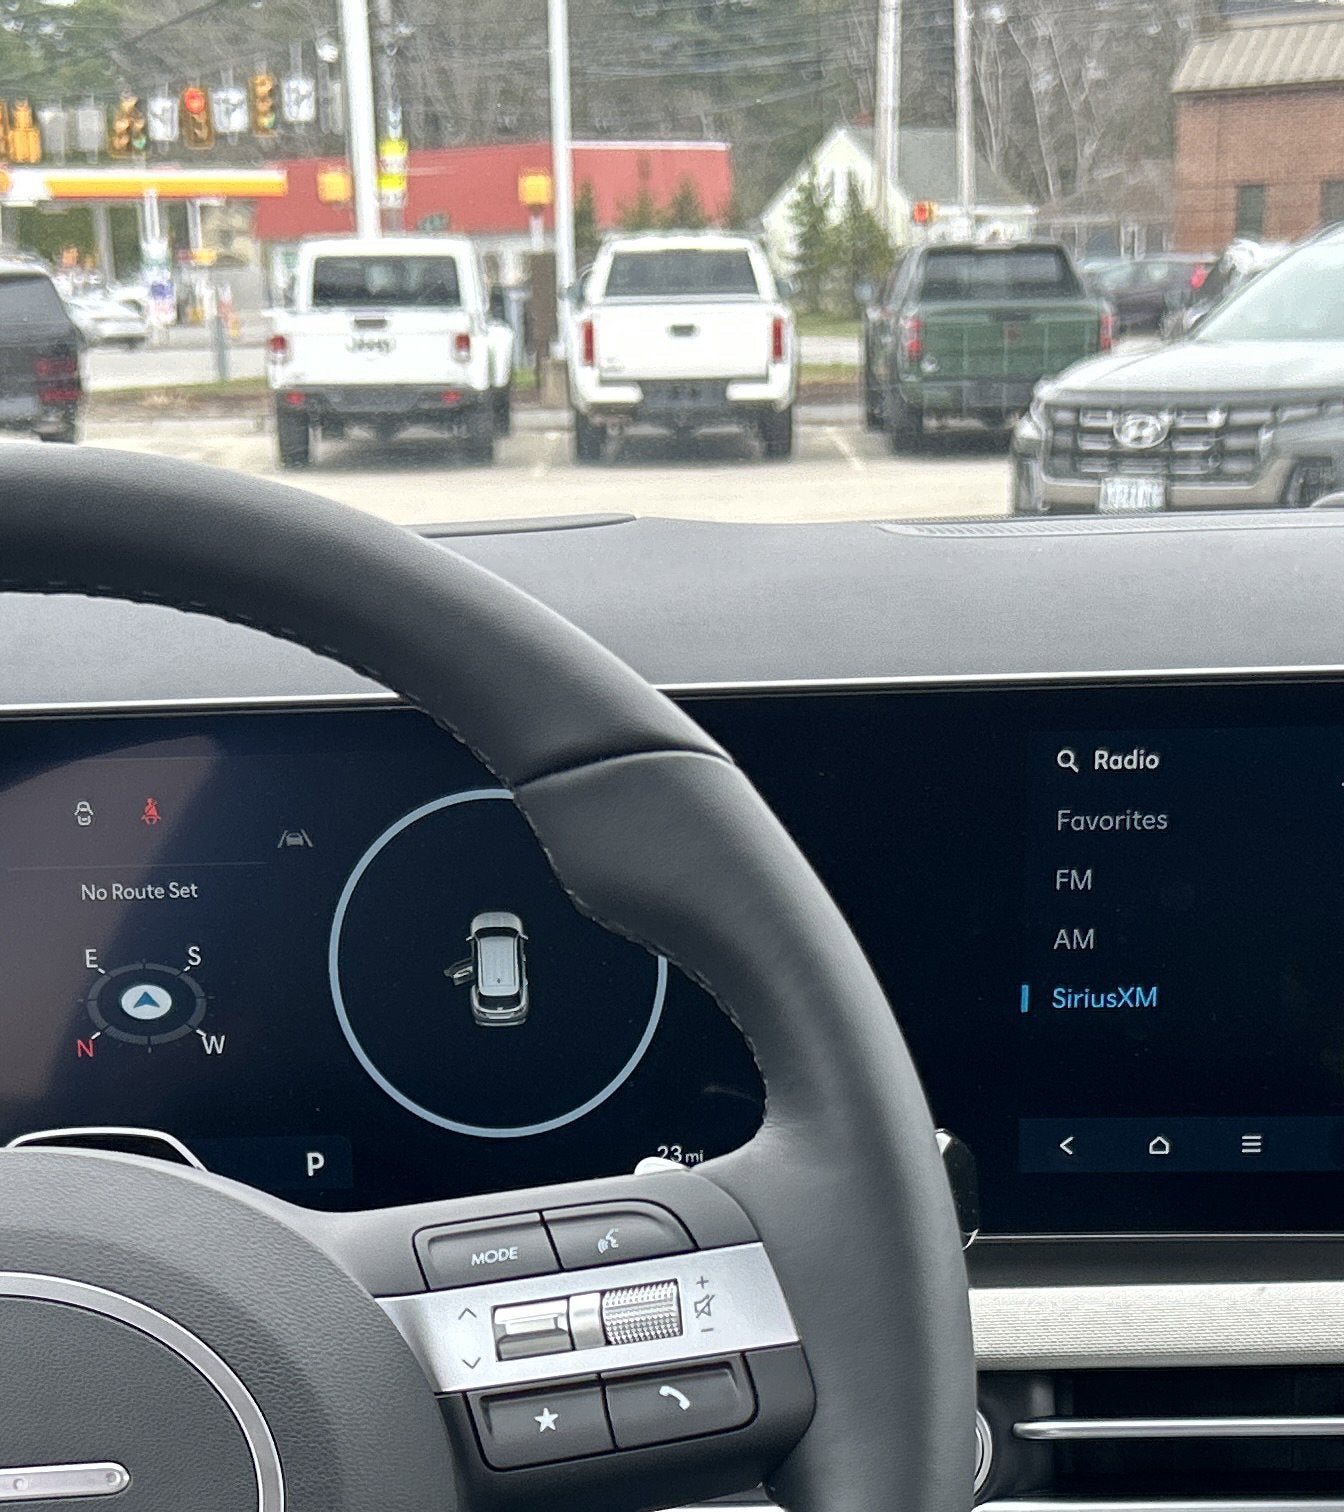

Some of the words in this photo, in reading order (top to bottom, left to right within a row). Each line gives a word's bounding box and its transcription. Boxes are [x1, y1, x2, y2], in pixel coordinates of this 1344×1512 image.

[1095, 749, 1159, 769] Radio
[1058, 810, 1167, 830] Favorites
[1056, 869, 1091, 890] FM
[82, 885, 107, 900] No
[112, 883, 164, 899] Route
[169, 882, 198, 898] Set
[1054, 929, 1094, 949] AM
[86, 949, 98, 967] E
[188, 946, 201, 965] S
[1052, 987, 1157, 1008] SiriusXM
[77, 1036, 97, 1057] N
[203, 1035, 225, 1054] W
[307, 1152, 324, 1176] P
[657, 1145, 682, 1162] 23
[686, 1150, 704, 1163] mi
[472, 1247, 518, 1265] MODE
